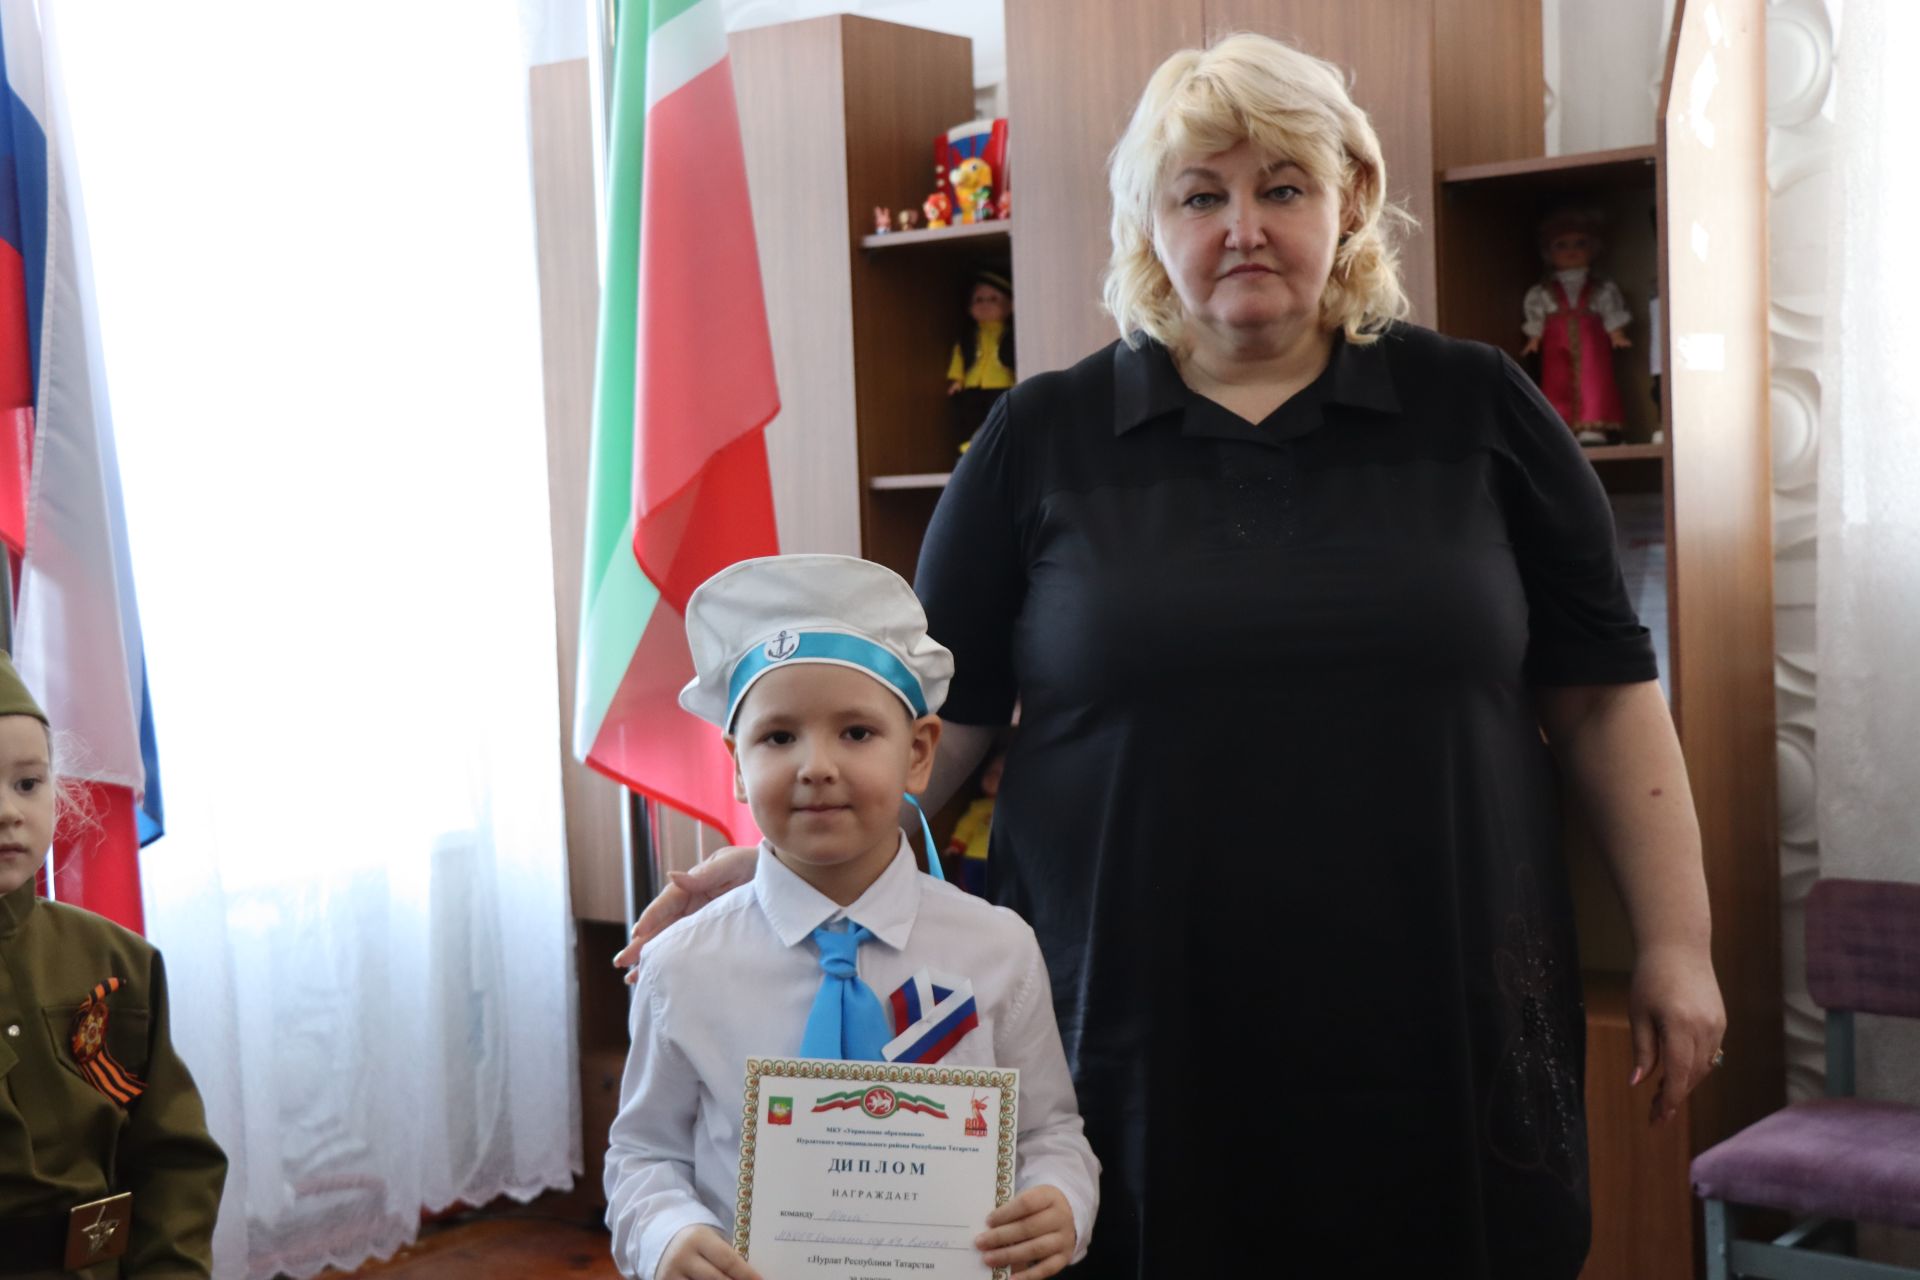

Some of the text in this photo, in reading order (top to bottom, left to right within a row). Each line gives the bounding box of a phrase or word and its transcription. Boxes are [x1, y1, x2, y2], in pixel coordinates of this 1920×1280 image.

[911, 1142, 946, 1152] Республики
[948, 1145, 979, 1154] Татарстан
[828, 1158, 925, 1175] ДИПЛОМ
[832, 1188, 919, 1201] НАГРАЖДАЕТ
[780, 1210, 814, 1220] команду
[844, 1256, 892, 1268] Республики
[895, 1259, 935, 1270] Татарстан
